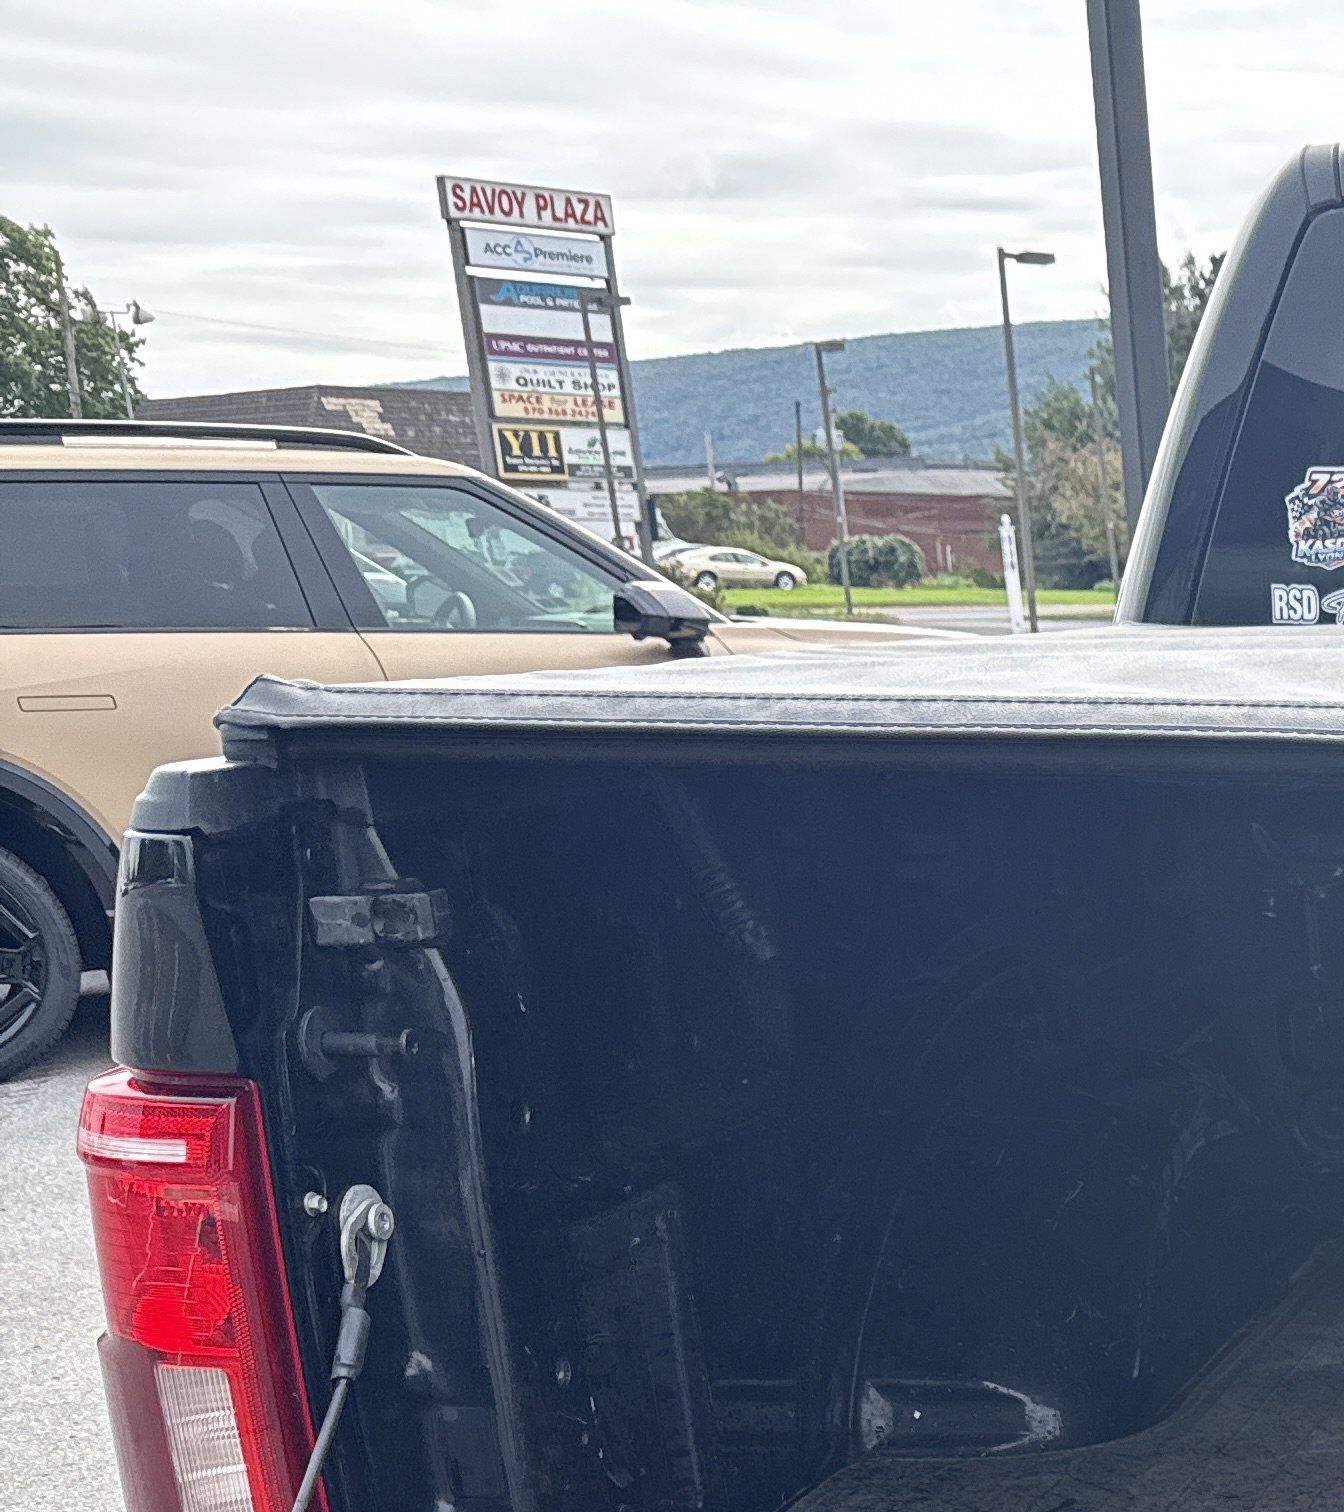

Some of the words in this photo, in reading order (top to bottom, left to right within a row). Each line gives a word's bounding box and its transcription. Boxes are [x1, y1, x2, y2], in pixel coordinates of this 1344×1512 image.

[452, 183, 526, 219] SAVOY
[535, 192, 609, 228] PLAZA
[484, 243, 512, 257] ACC
[534, 247, 593, 265] Premiere
[492, 340, 525, 354] UPMC
[576, 347, 610, 358] CETER
[515, 376, 565, 390] QUILT
[500, 393, 543, 405] SPACE
[1273, 588, 1315, 621] RSD
